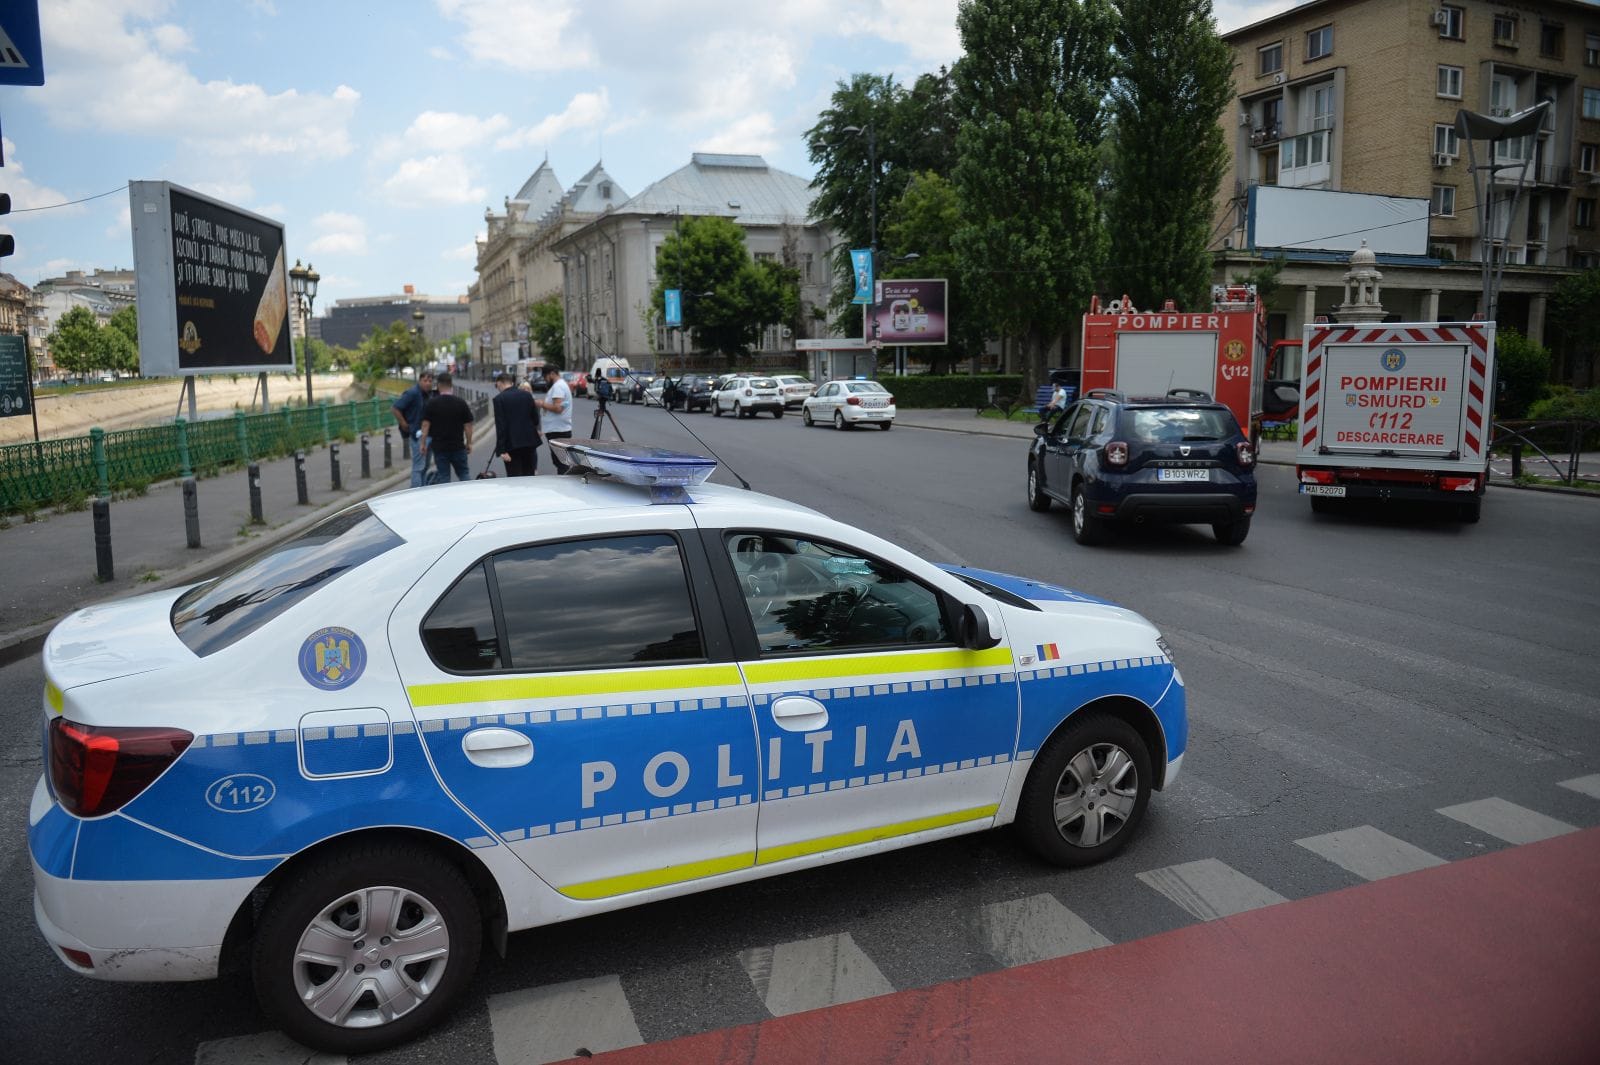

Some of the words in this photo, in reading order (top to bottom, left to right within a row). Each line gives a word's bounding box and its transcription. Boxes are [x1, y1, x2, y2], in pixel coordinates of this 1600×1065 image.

[174, 211, 189, 234] DUPĂ
[1117, 316, 1230, 329] POMPIERI
[1228, 366, 1249, 377] 112
[1340, 376, 1447, 392] POMPIERII
[1358, 394, 1426, 409] SMURD
[1377, 412, 1413, 430] 112
[1337, 431, 1444, 446] DESCARCERARE
[581, 719, 922, 809] POLITIA
[229, 785, 266, 805] 112
